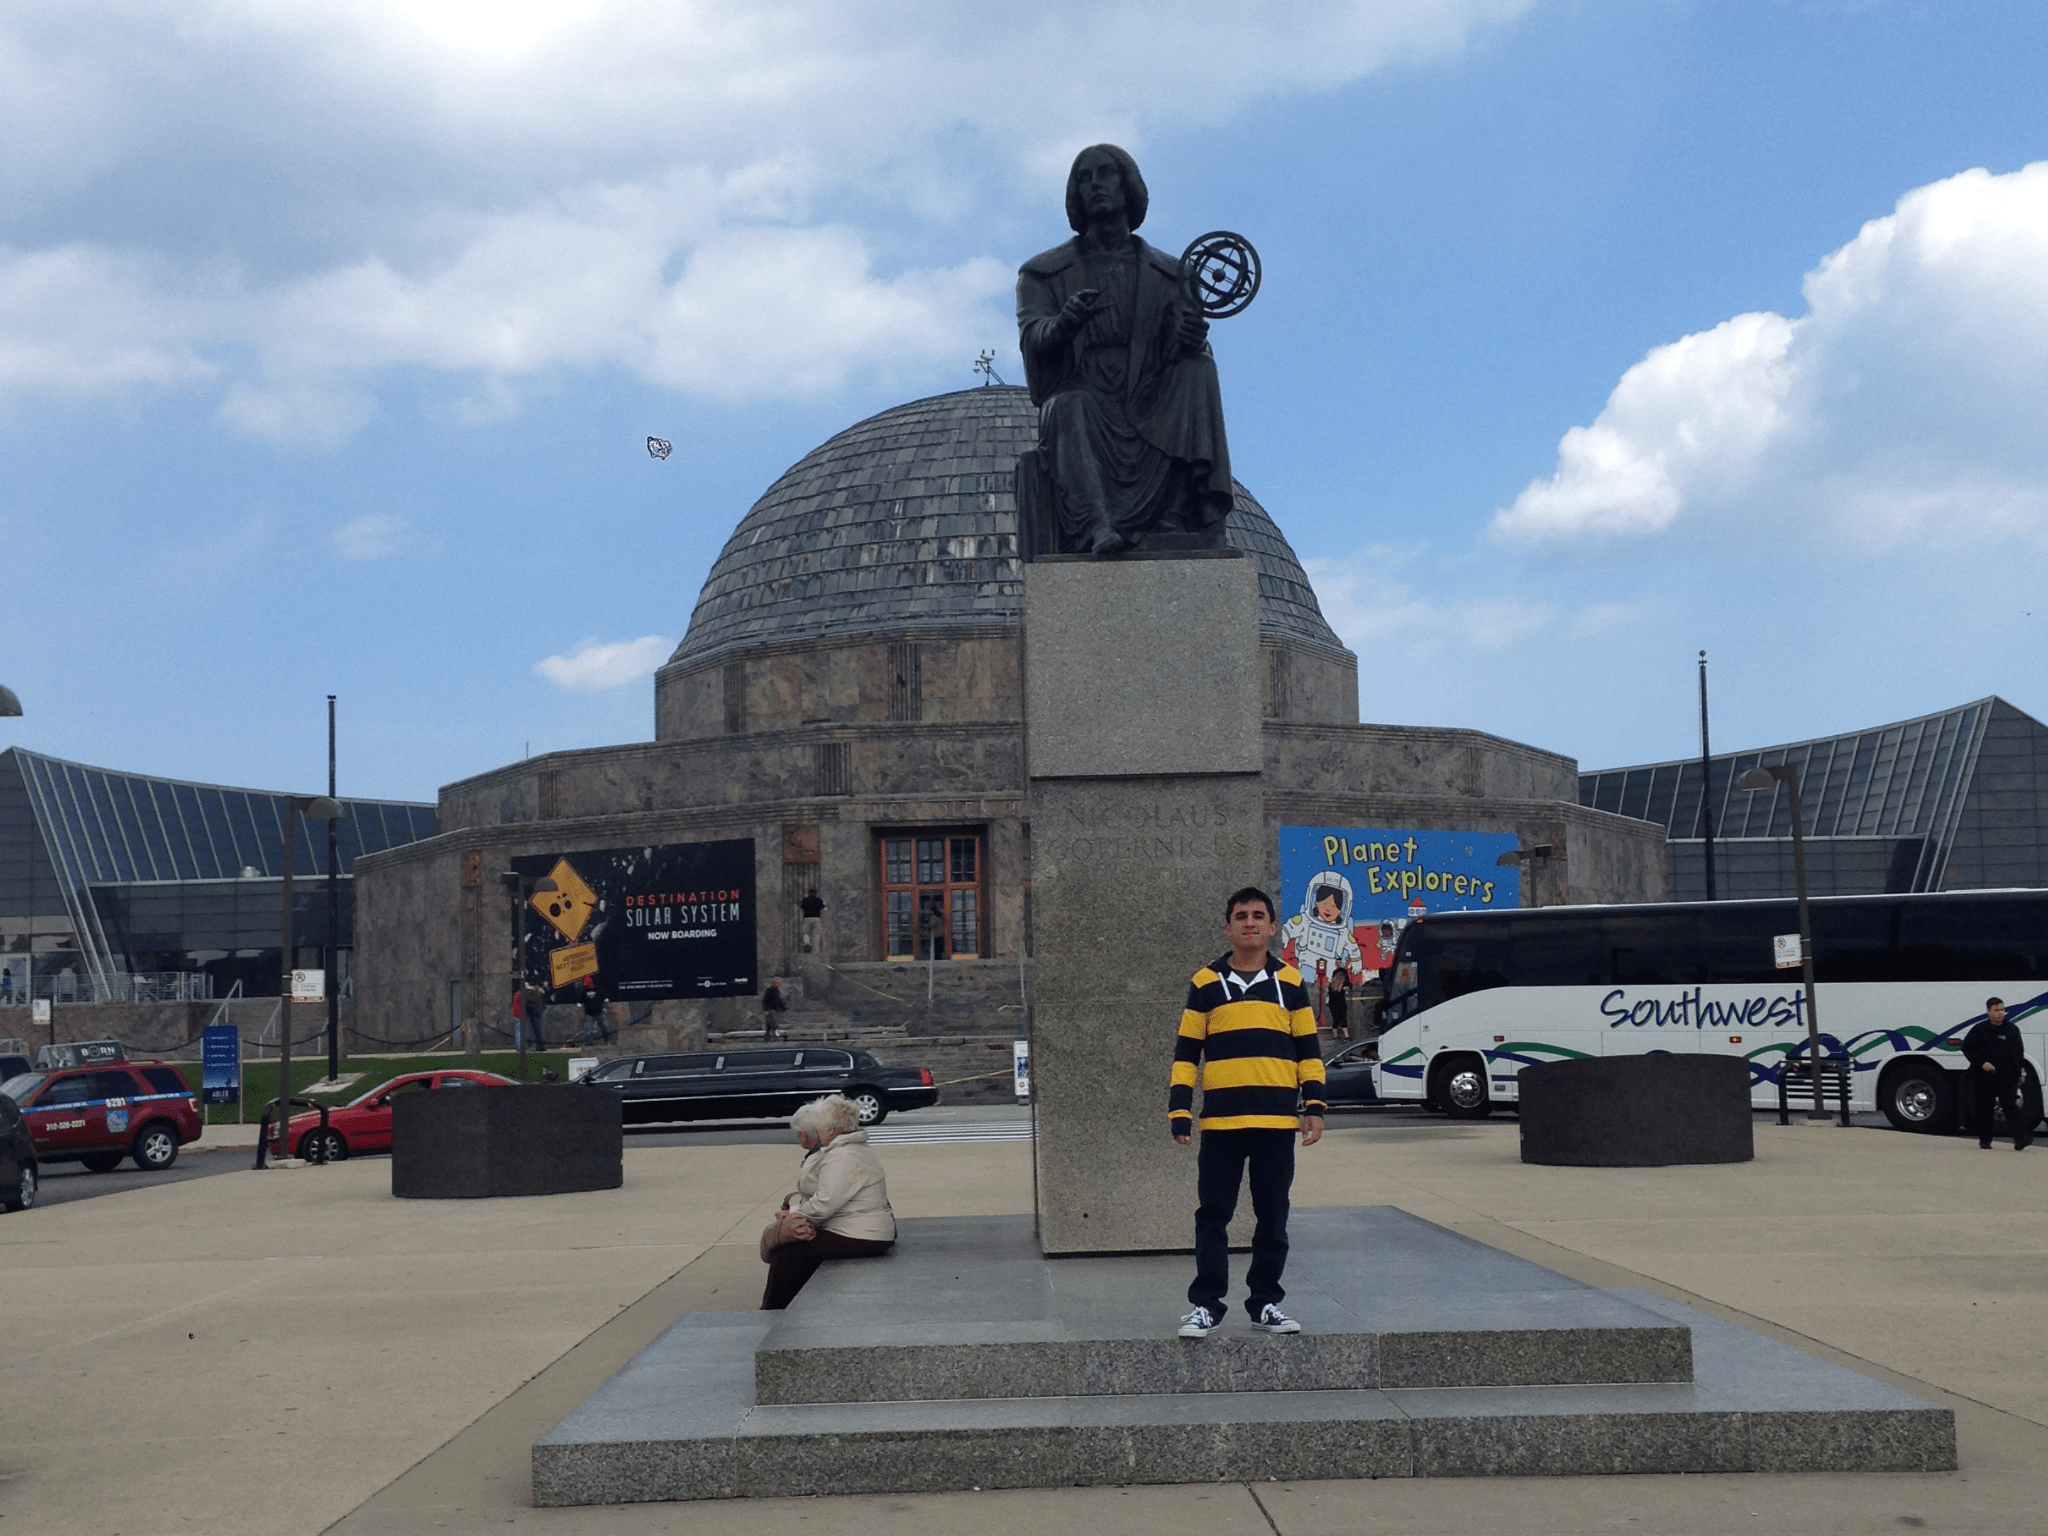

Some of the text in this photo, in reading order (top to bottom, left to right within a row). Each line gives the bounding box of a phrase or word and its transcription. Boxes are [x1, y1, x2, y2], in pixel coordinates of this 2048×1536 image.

[1066, 803, 1229, 829] NICOLAUS
[1047, 833, 1248, 862] COPERNICUS
[1322, 834, 1419, 867] Planet
[1367, 864, 1496, 904] Explorers
[625, 889, 740, 907] DESTINATION
[626, 902, 740, 927] SOLAR SYSTEM
[647, 928, 717, 940] NOW BOARDING
[1600, 986, 1807, 1030] Southwest
[105, 1097, 126, 1108] 6291
